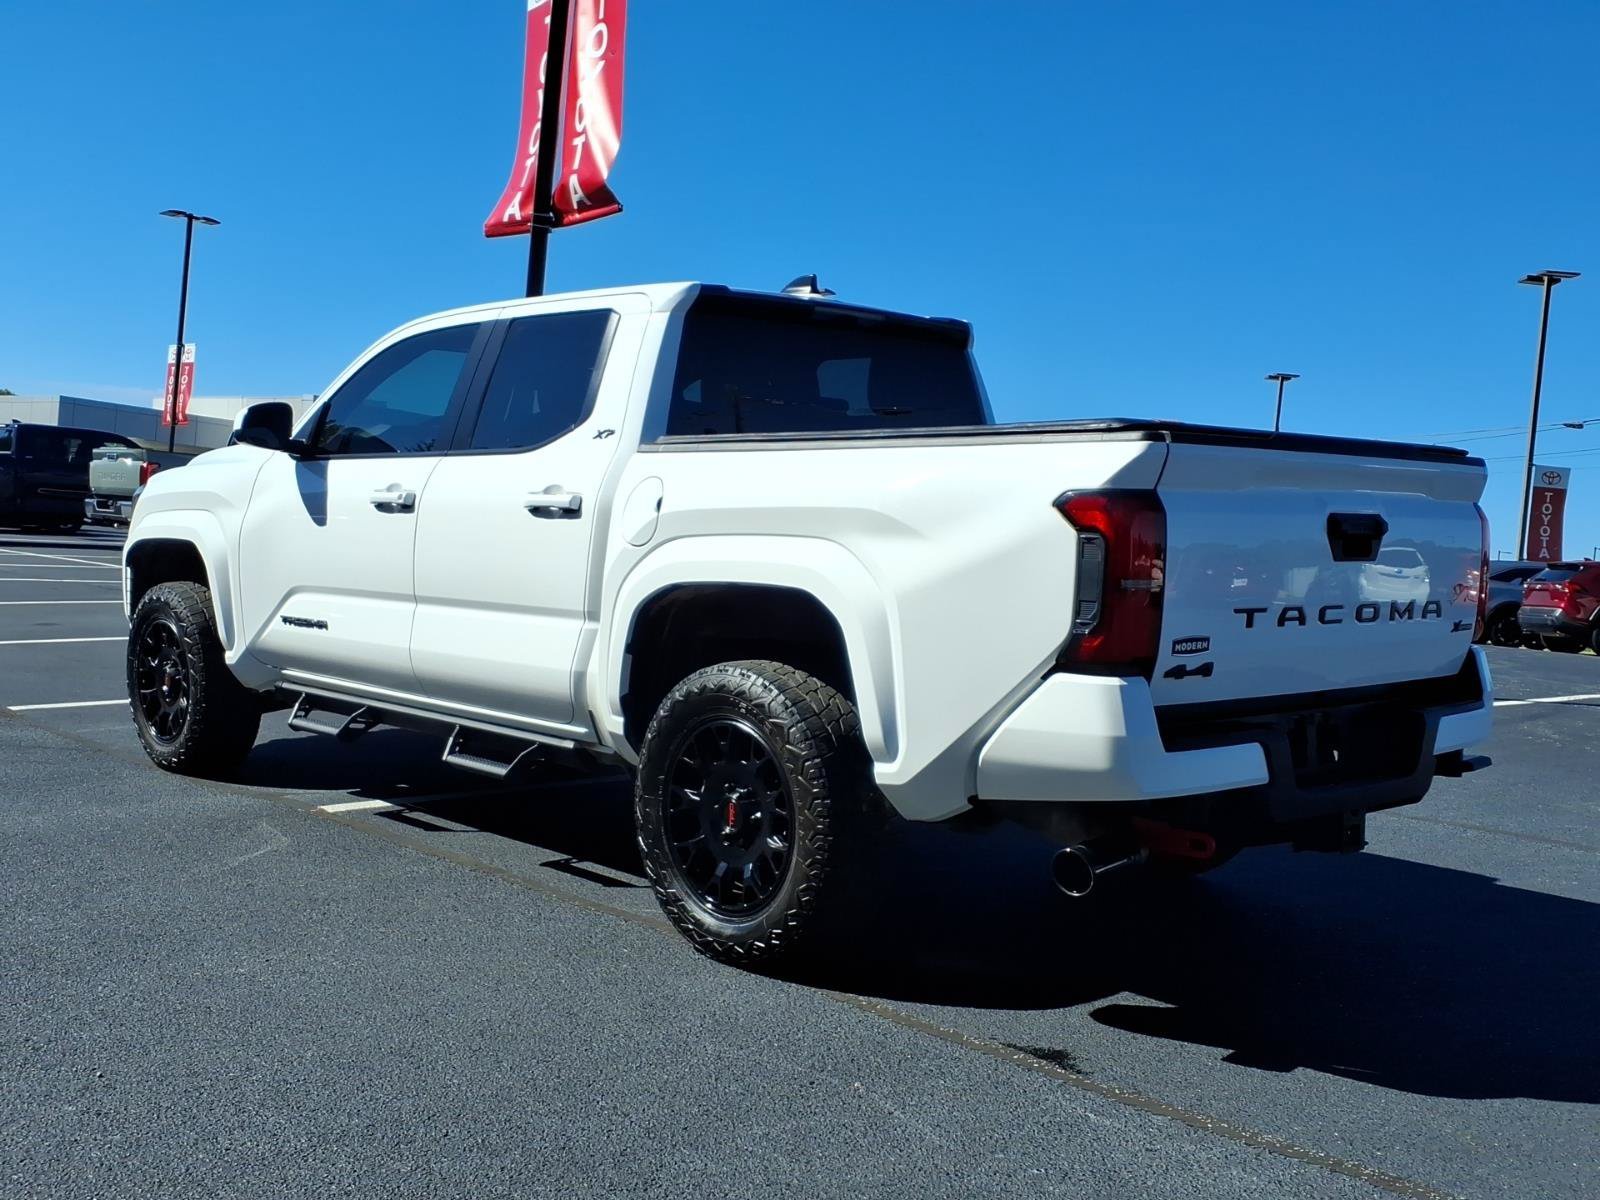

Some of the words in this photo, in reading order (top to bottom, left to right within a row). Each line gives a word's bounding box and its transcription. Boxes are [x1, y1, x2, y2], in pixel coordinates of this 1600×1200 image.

[1539, 492, 1554, 559] TOYOTA
[1233, 599, 1442, 629] TACOMA
[1175, 640, 1209, 652] MODERN
